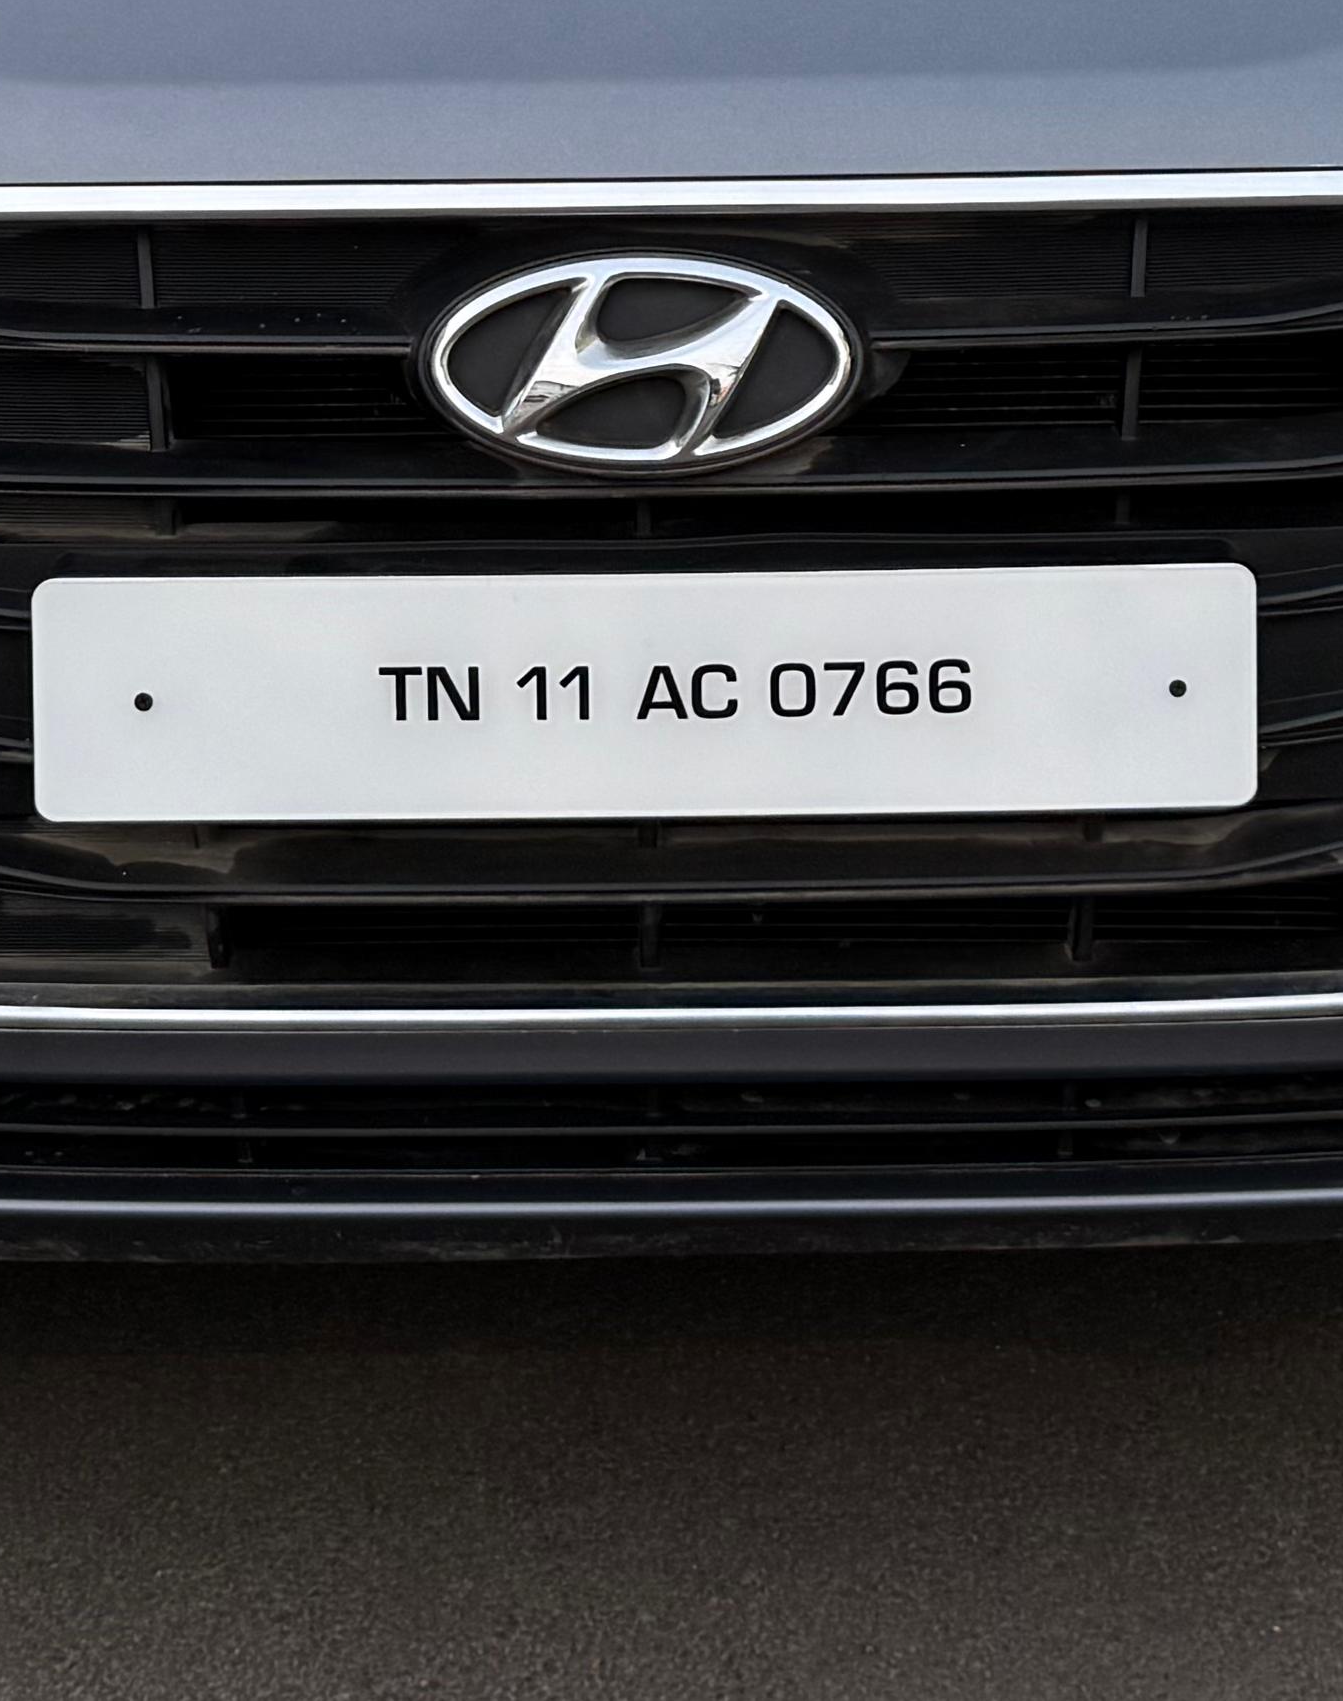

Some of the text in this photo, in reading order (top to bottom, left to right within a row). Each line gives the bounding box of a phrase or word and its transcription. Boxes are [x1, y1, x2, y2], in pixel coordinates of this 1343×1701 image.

[378, 658, 972, 722] TN 11 AC 0766
